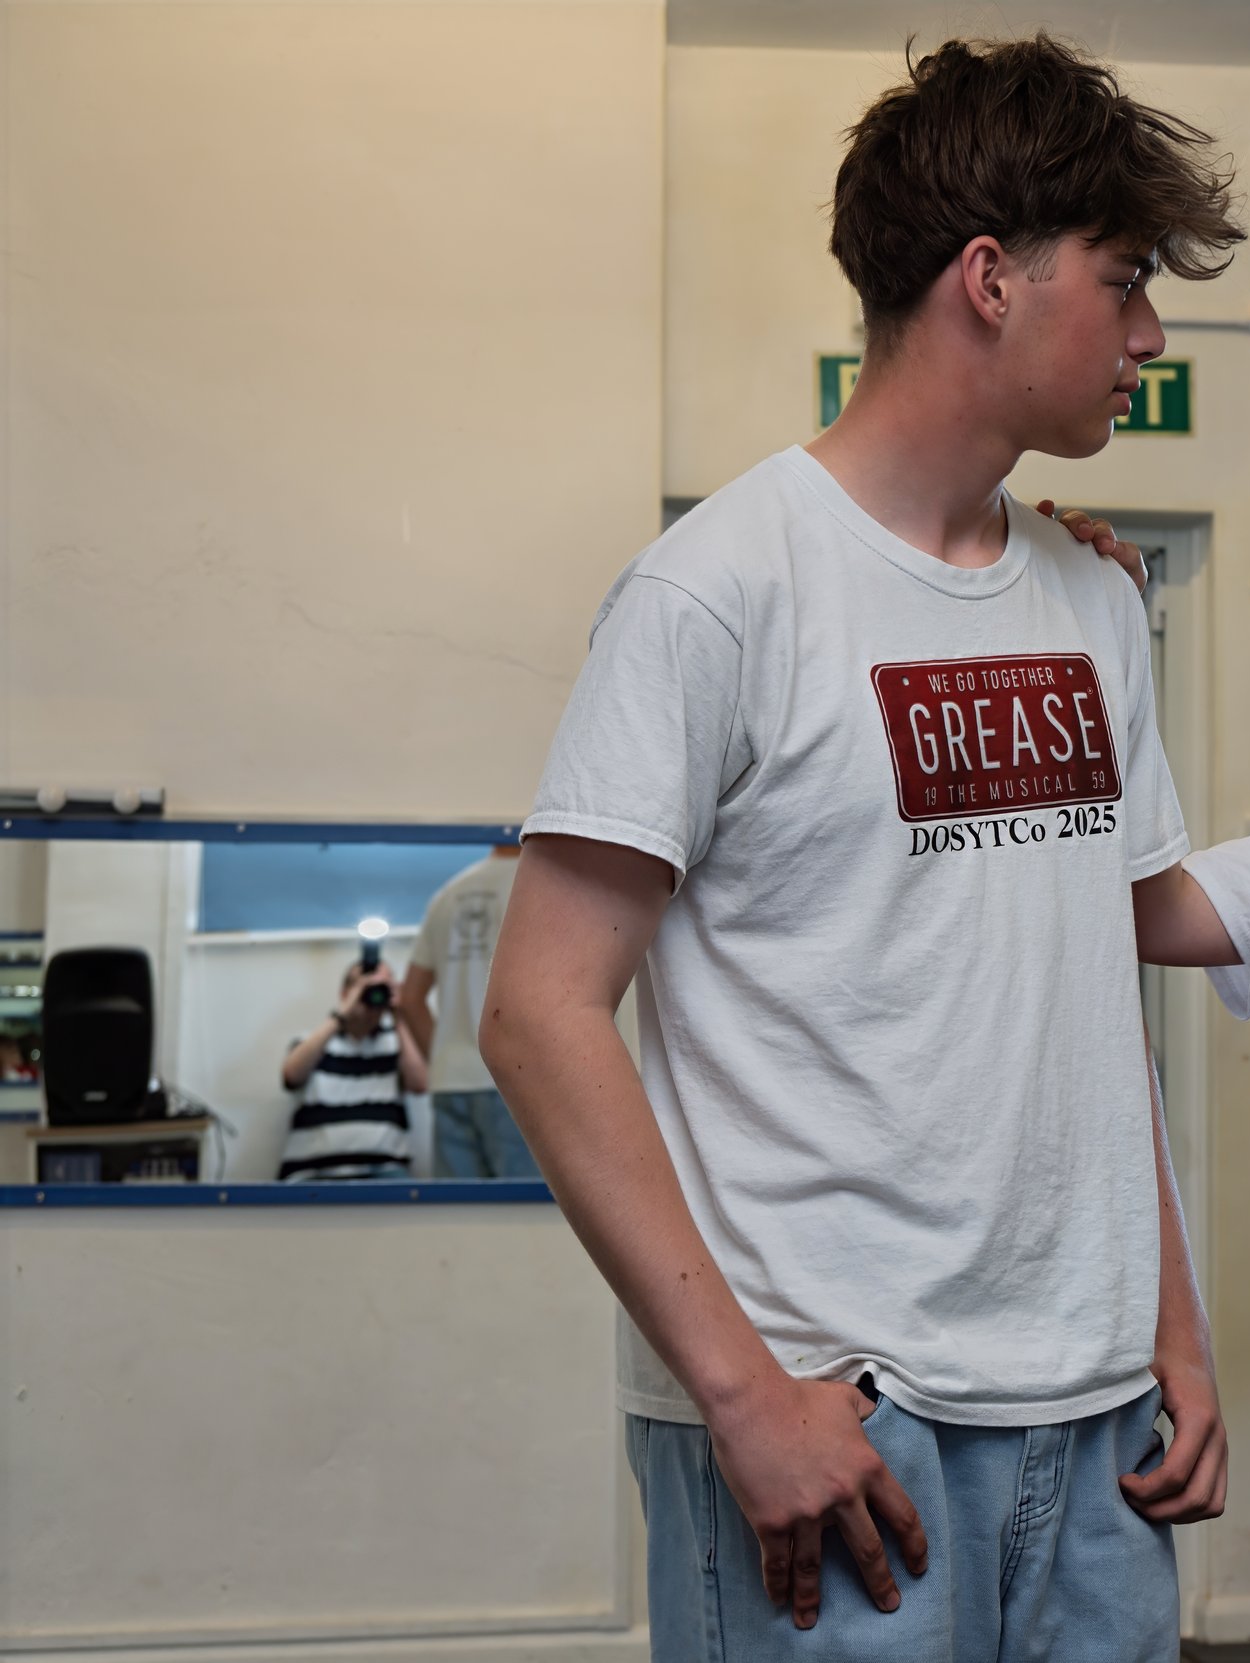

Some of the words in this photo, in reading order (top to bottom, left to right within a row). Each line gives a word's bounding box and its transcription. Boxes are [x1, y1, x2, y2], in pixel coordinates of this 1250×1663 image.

[928, 673, 950, 693] WE
[956, 671, 976, 692] GO
[981, 667, 1055, 690] TOGETHER
[909, 692, 1101, 775] GREASE
[925, 786, 937, 806] 19
[948, 783, 977, 804] THE
[989, 773, 1076, 800] MUSICAL
[1091, 771, 1105, 789] 59
[908, 817, 1046, 856] DOSYTCo
[1056, 805, 1116, 838] 2025
